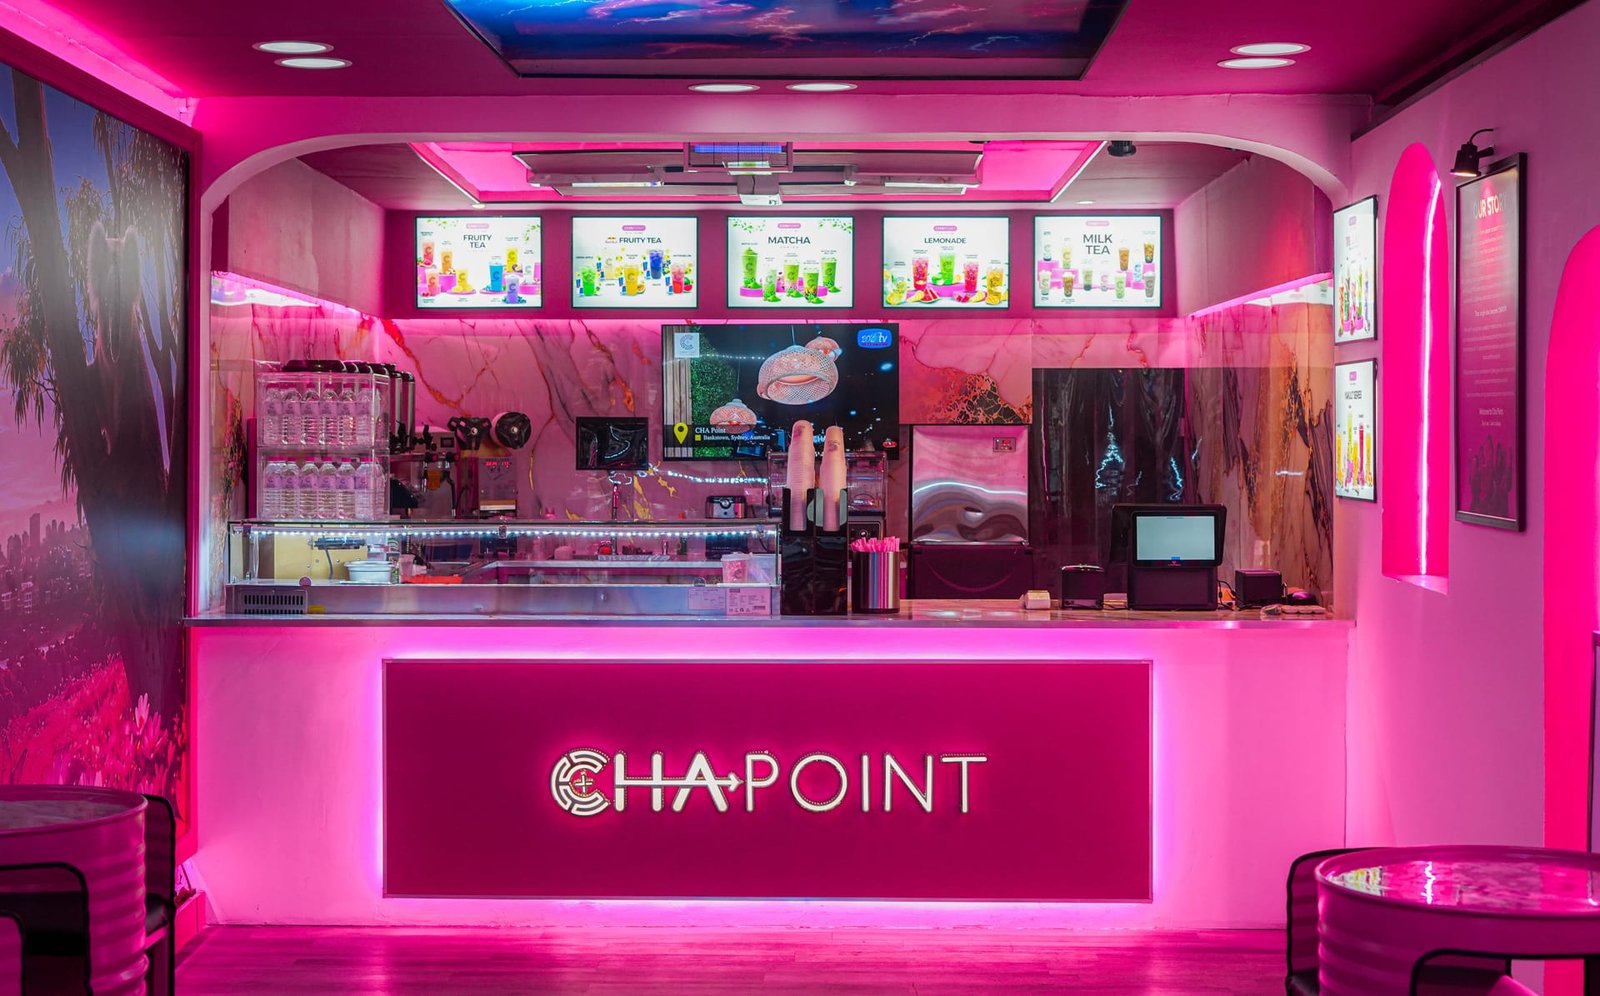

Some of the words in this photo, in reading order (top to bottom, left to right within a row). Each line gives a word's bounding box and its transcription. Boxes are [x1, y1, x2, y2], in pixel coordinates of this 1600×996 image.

[768, 236, 811, 245] MATCHA
[1082, 234, 1113, 244] MILK
[469, 241, 486, 249] TEA
[1085, 245, 1111, 255] TEA
